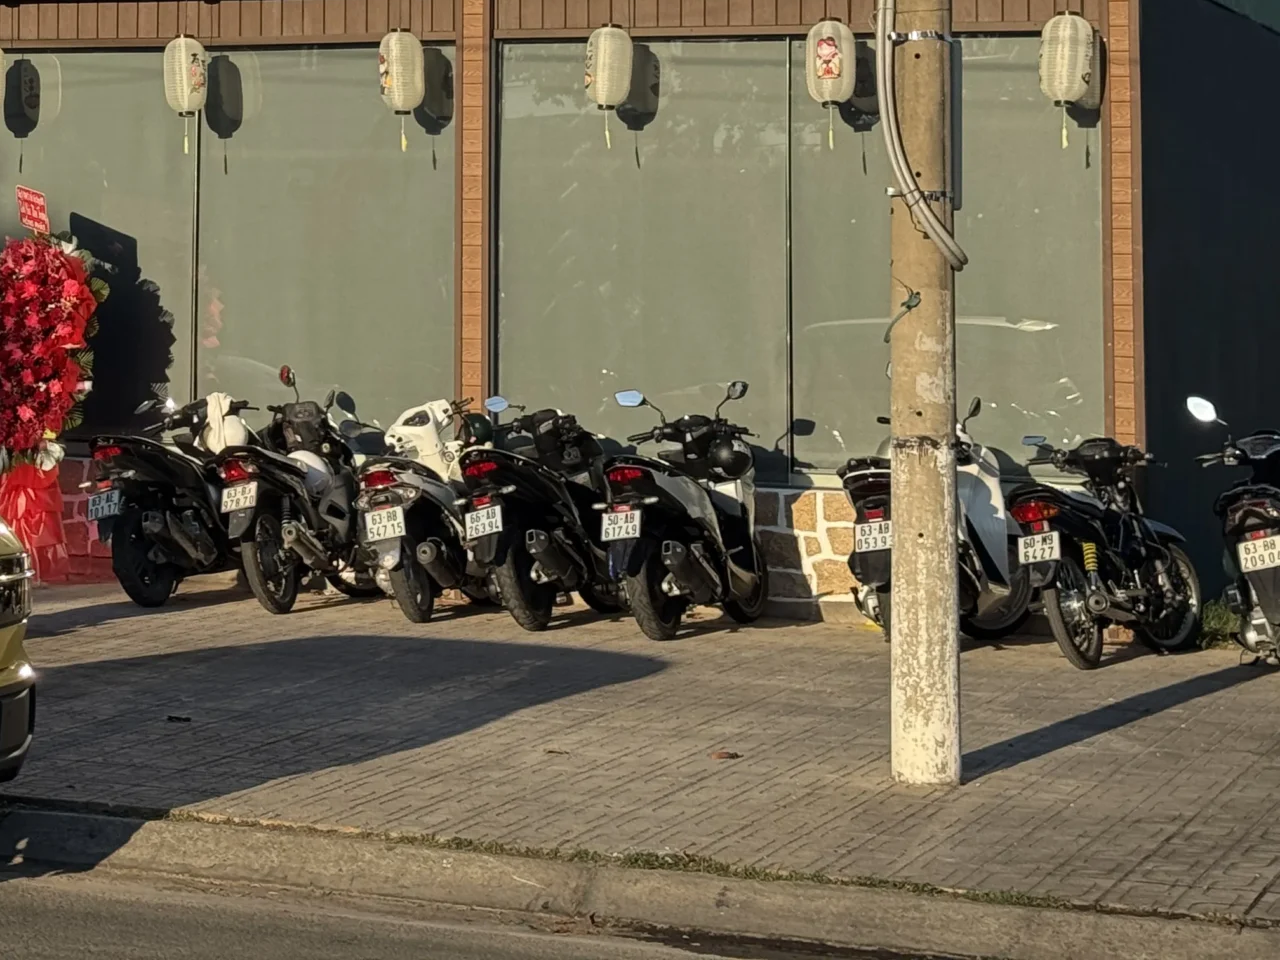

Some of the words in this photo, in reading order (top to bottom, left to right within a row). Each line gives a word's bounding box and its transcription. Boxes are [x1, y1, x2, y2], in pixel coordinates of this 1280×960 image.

[470, 508, 496, 524] 66-AB
[607, 513, 635, 526] 50-AB
[604, 524, 637, 539] 617.49
[860, 523, 890, 537] 63-AB
[1023, 534, 1054, 549] 60-M9
[1244, 539, 1276, 555] 63-B8
[1023, 546, 1054, 561] 6427
